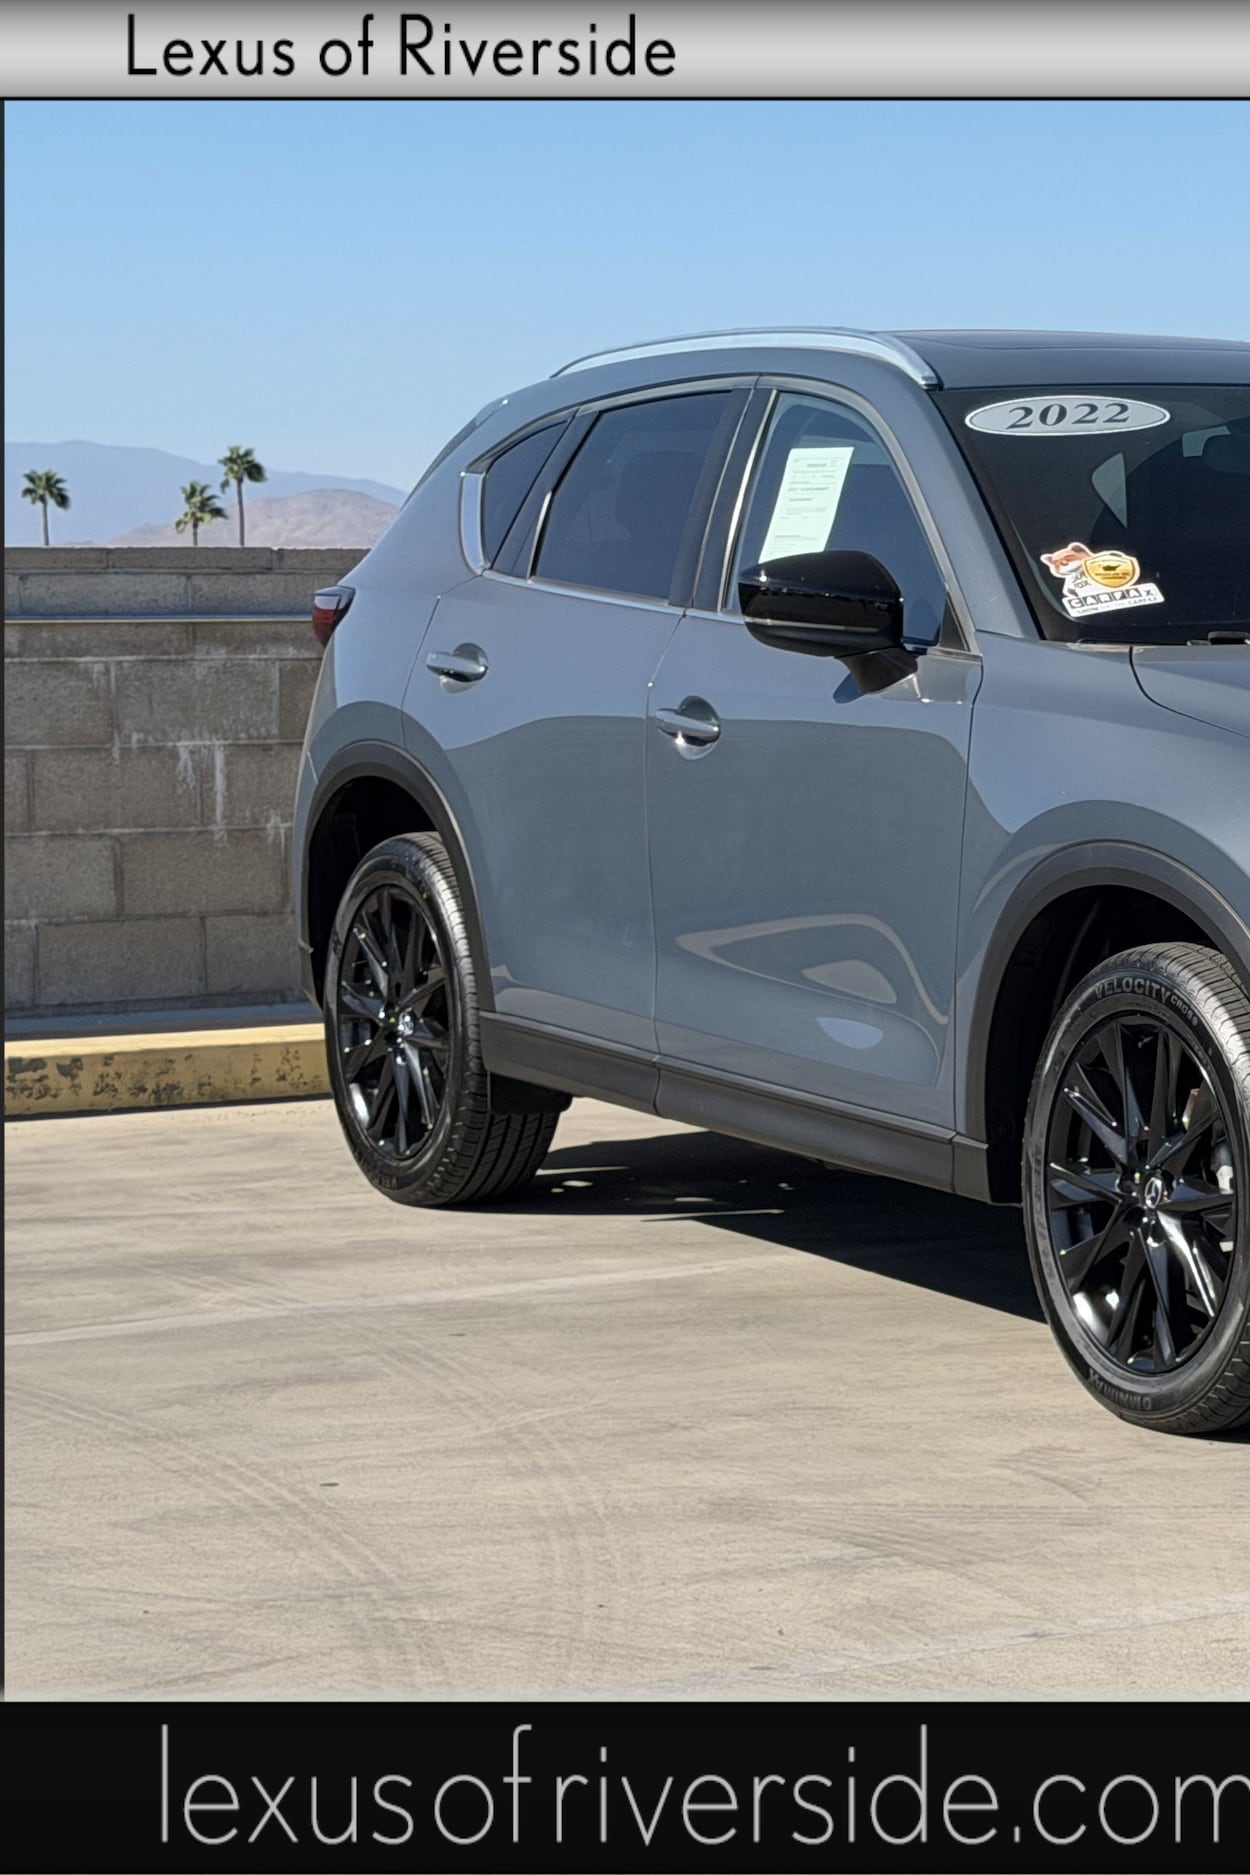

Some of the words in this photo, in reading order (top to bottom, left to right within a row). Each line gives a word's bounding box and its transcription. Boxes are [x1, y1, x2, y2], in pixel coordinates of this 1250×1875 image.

[1005, 402, 1130, 430] 2022
[1067, 588, 1154, 610] CARFAX
[1095, 976, 1173, 1004] VELOCITY
[1170, 994, 1199, 1027] CROSS
